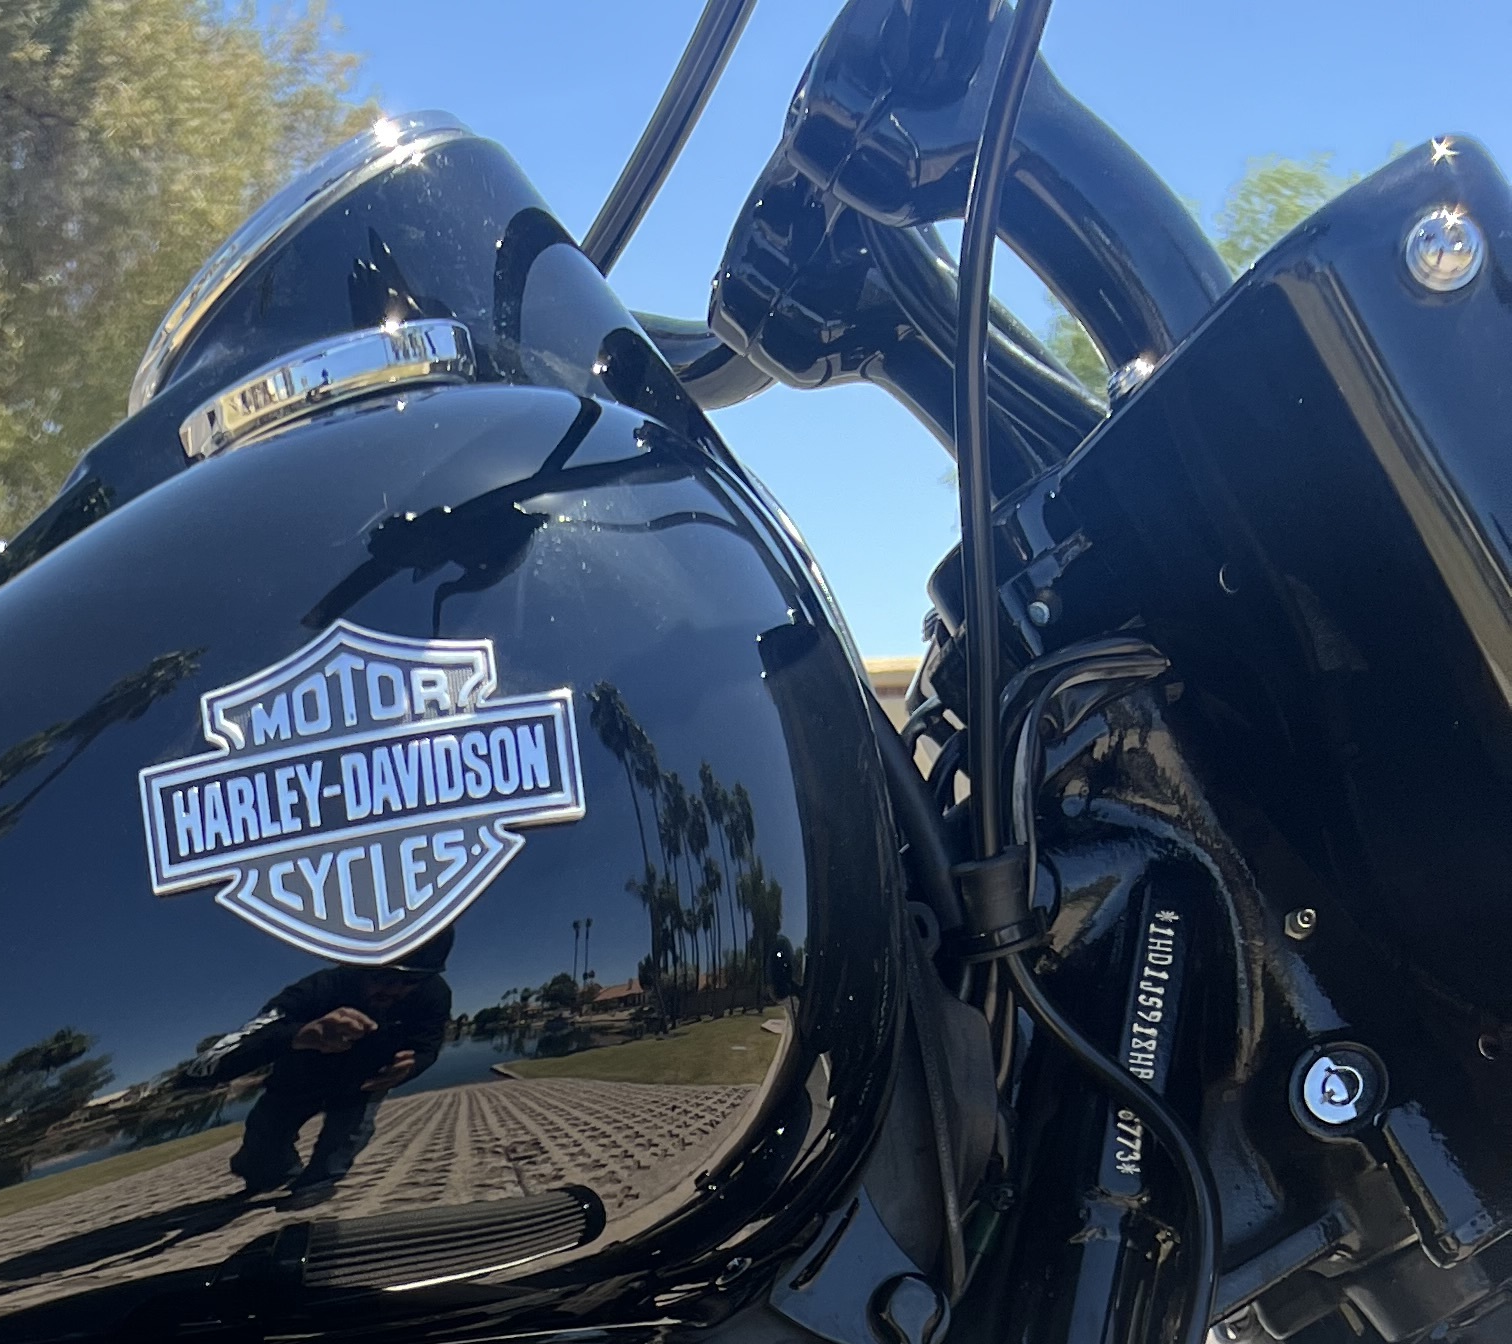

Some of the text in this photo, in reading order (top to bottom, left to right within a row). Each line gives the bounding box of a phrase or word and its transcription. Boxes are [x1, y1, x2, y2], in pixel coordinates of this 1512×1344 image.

[251, 652, 451, 746] MOTOR
[171, 723, 551, 857] HARLEY-DAVIDSON
[267, 829, 468, 932] CYCLES
